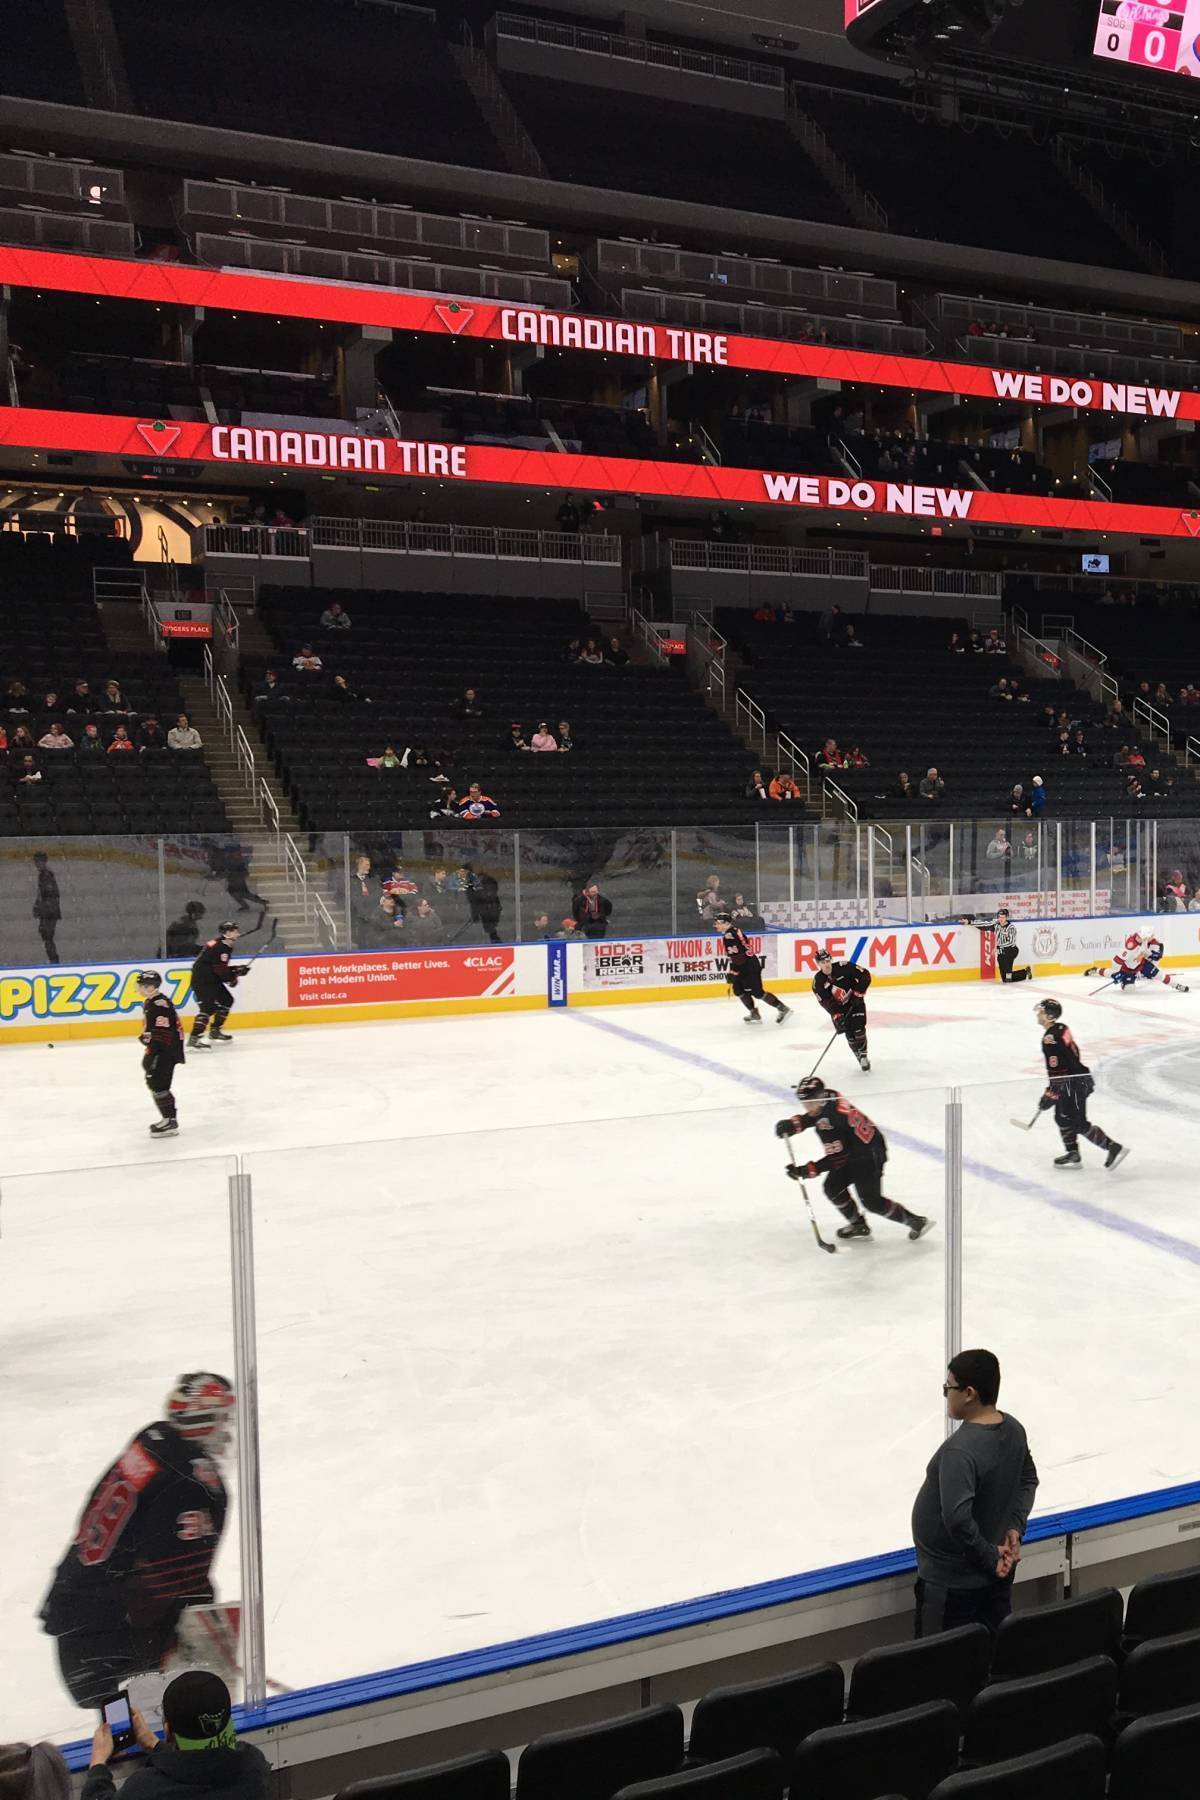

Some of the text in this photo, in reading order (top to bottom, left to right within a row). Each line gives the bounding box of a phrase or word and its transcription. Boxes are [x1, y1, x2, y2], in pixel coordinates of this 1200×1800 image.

[1107, 16, 1126, 29] SOG
[1107, 33, 1120, 52] 0
[1144, 30, 1166, 64] 0
[502, 309, 728, 365] CANADIAN TIRE
[992, 370, 1181, 418] WE DO NEW
[211, 426, 467, 477] CANADIAN TIRE
[763, 474, 973, 519] WE DO NEW
[666, 940, 703, 959] YUKON
[704, 941, 713, 955] &
[1065, 937, 1076, 950] The
[1079, 936, 1101, 949] Sutton
[794, 932, 957, 973] RE/MAX
[299, 960, 451, 975] Better Workplaces. Better Lives.
[470, 956, 503, 967] CLAC
[658, 962, 681, 974] THE
[599, 967, 641, 976] ROCKS
[671, 974, 707, 983] MORNING
[299, 977, 318, 987] Join
[328, 975, 365, 984] Modern
[367, 974, 398, 983] Union.
[299, 992, 347, 1001] Visit clac.ca
